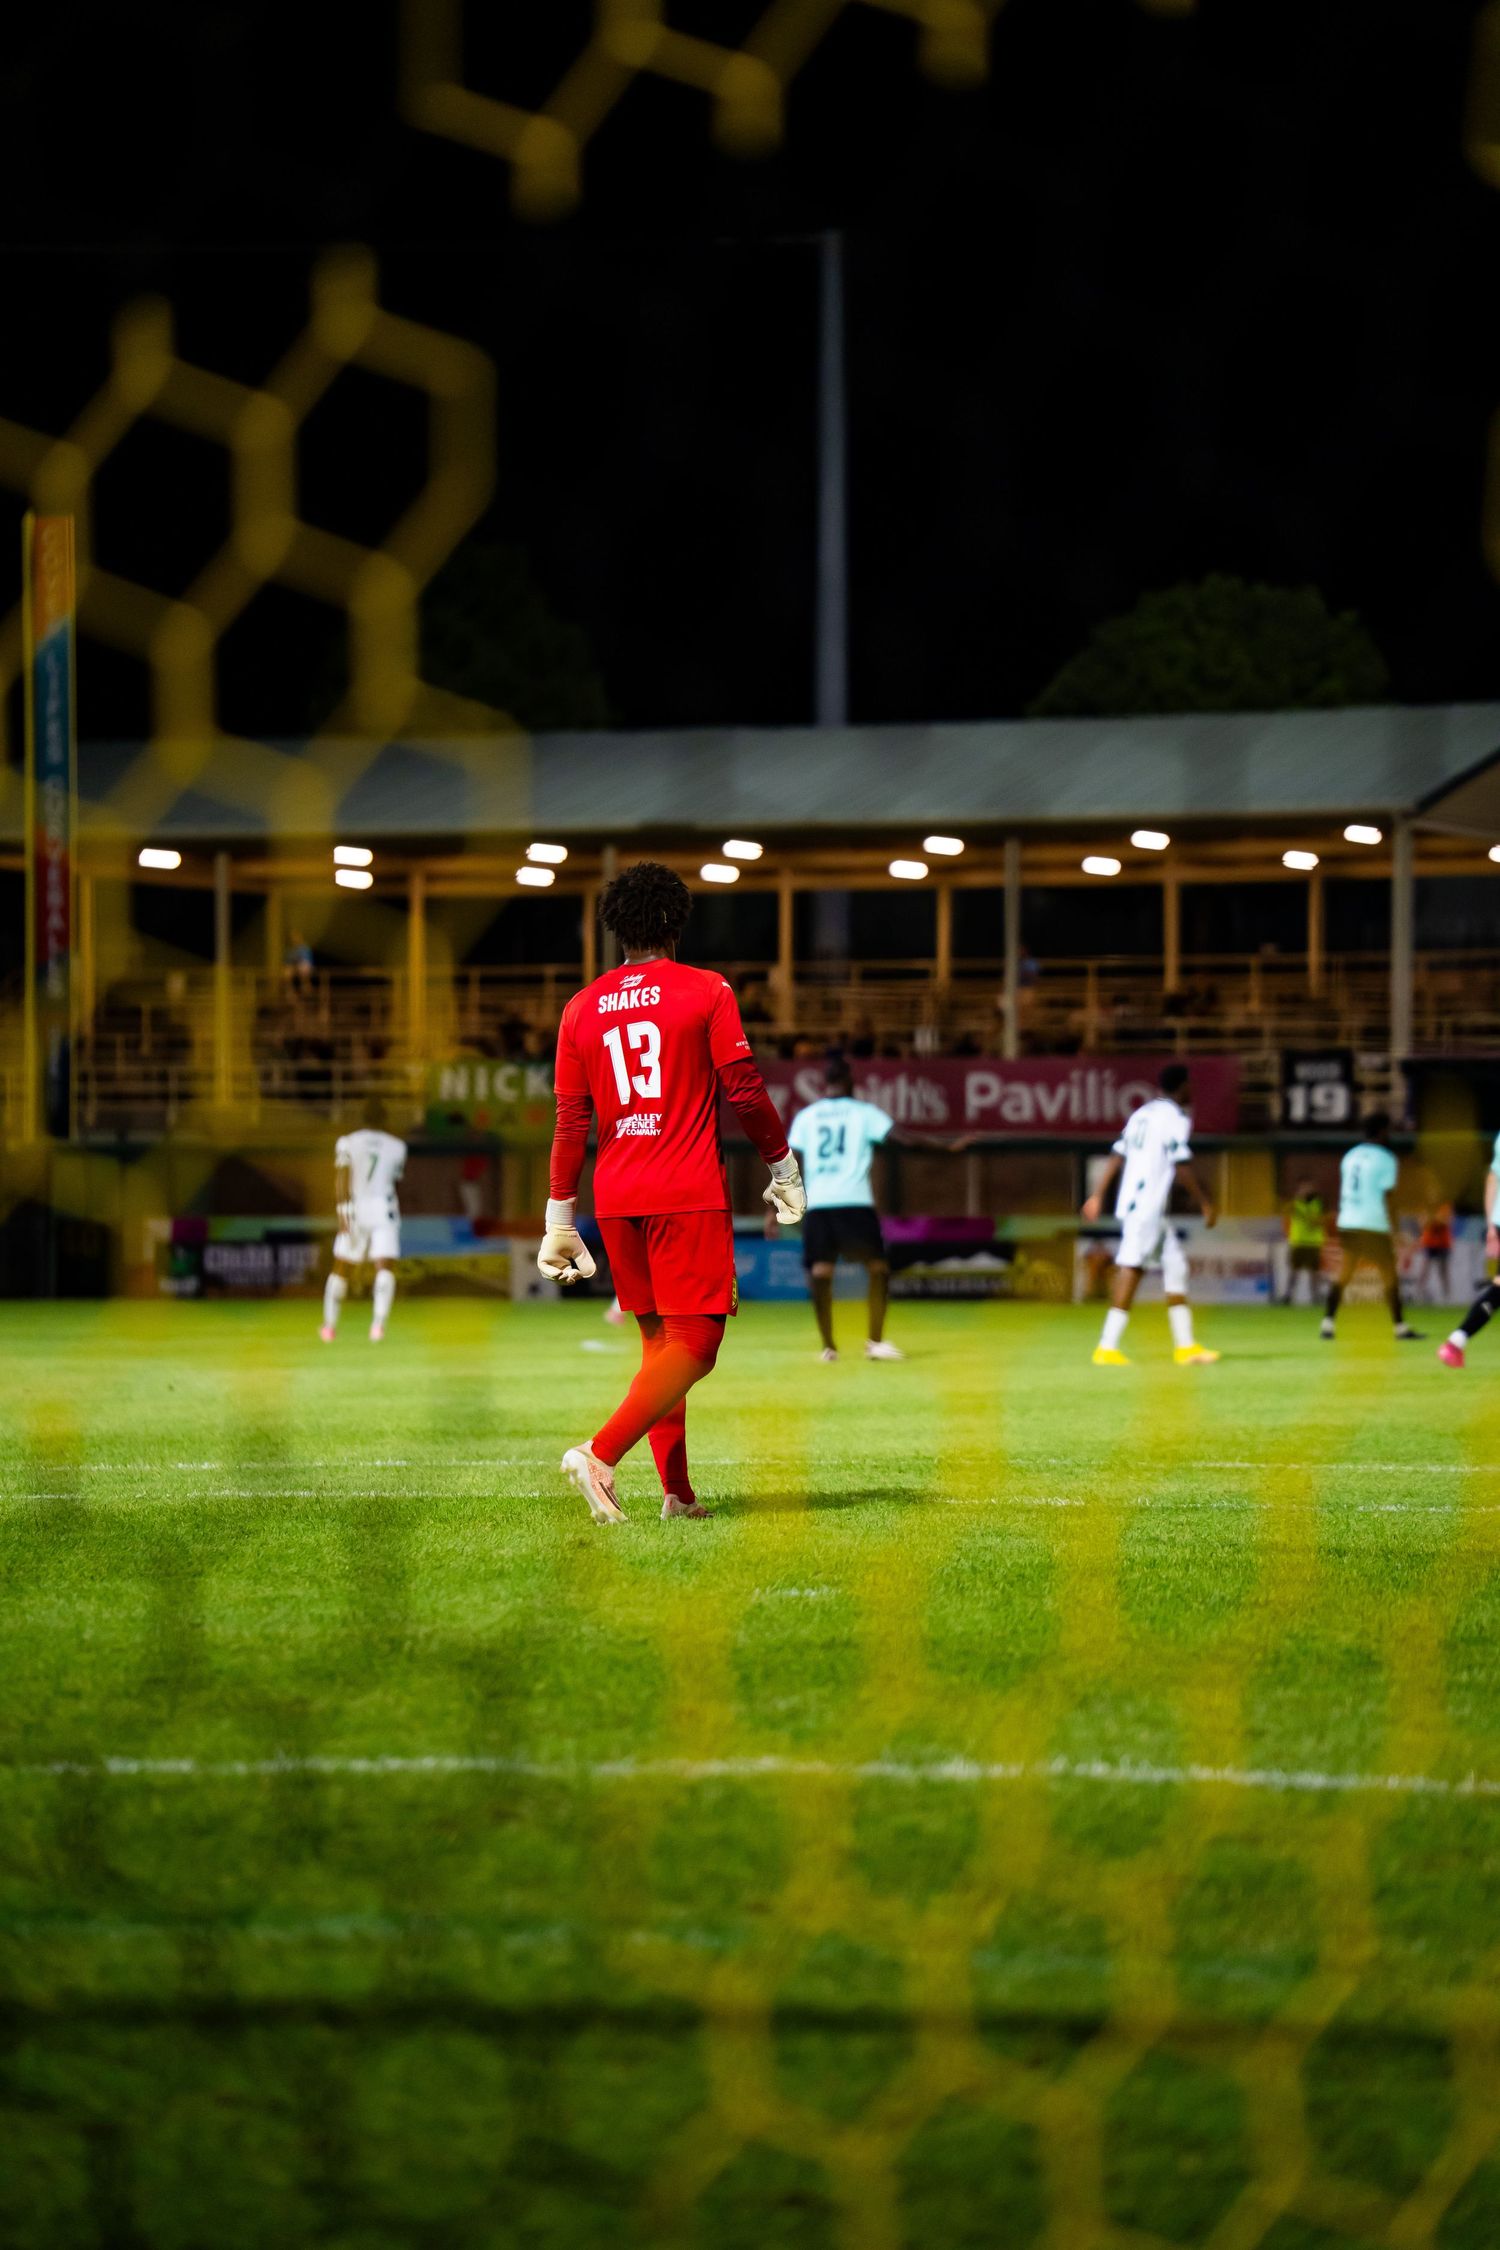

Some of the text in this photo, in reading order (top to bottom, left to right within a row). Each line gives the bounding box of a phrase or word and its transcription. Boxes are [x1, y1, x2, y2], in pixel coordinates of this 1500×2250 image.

[598, 985, 661, 1014] SHAKES
[602, 1020, 662, 1105] 13
[964, 1069, 1190, 1123] Pavilio
[1287, 1081, 1349, 1123] 19
[625, 1128, 662, 1136] COMPANY
[817, 1124, 847, 1158] 24
[368, 1152, 380, 1183] 7
